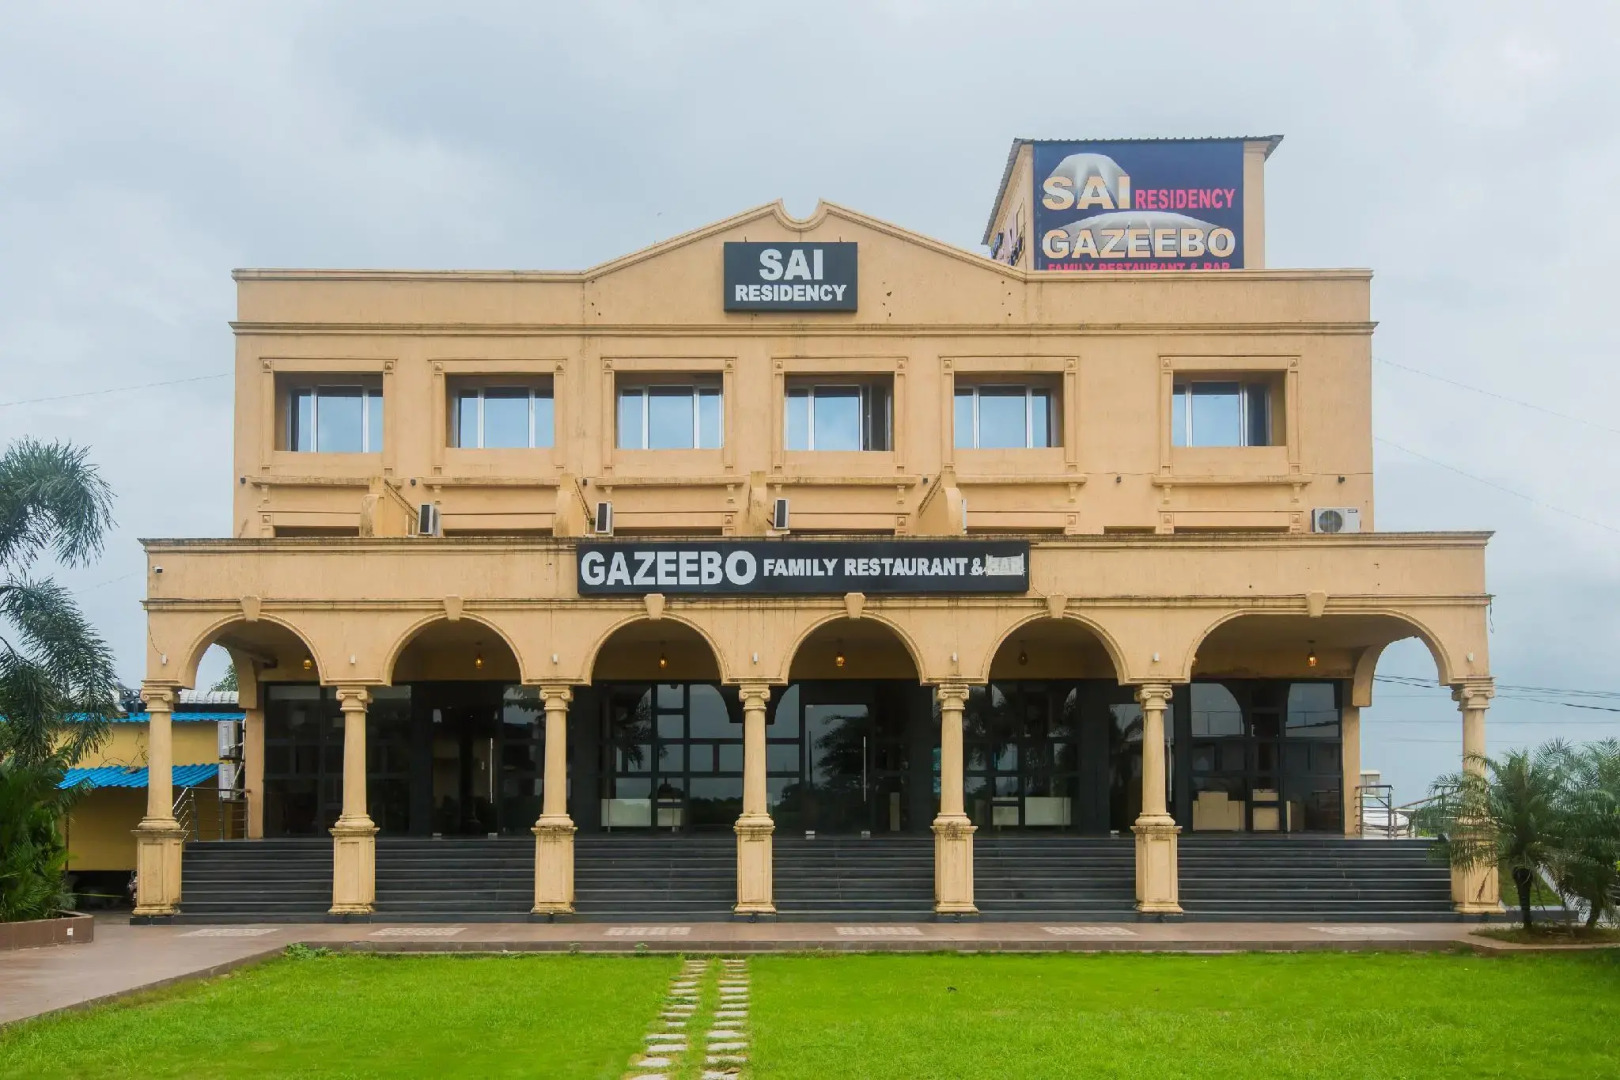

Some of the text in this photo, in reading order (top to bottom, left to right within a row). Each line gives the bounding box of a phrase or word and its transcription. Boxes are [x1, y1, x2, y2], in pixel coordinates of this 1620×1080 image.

[1042, 175, 1236, 210] SAI RESIDENCY
[1042, 227, 1236, 259] GAZEEBO
[758, 248, 824, 281] SAI
[735, 284, 848, 302] RESIDENCY
[580, 550, 757, 586] GAZEEBO
[763, 558, 839, 577] FAMILY
[844, 557, 969, 577] RESTAURANT
[970, 557, 985, 576] &
